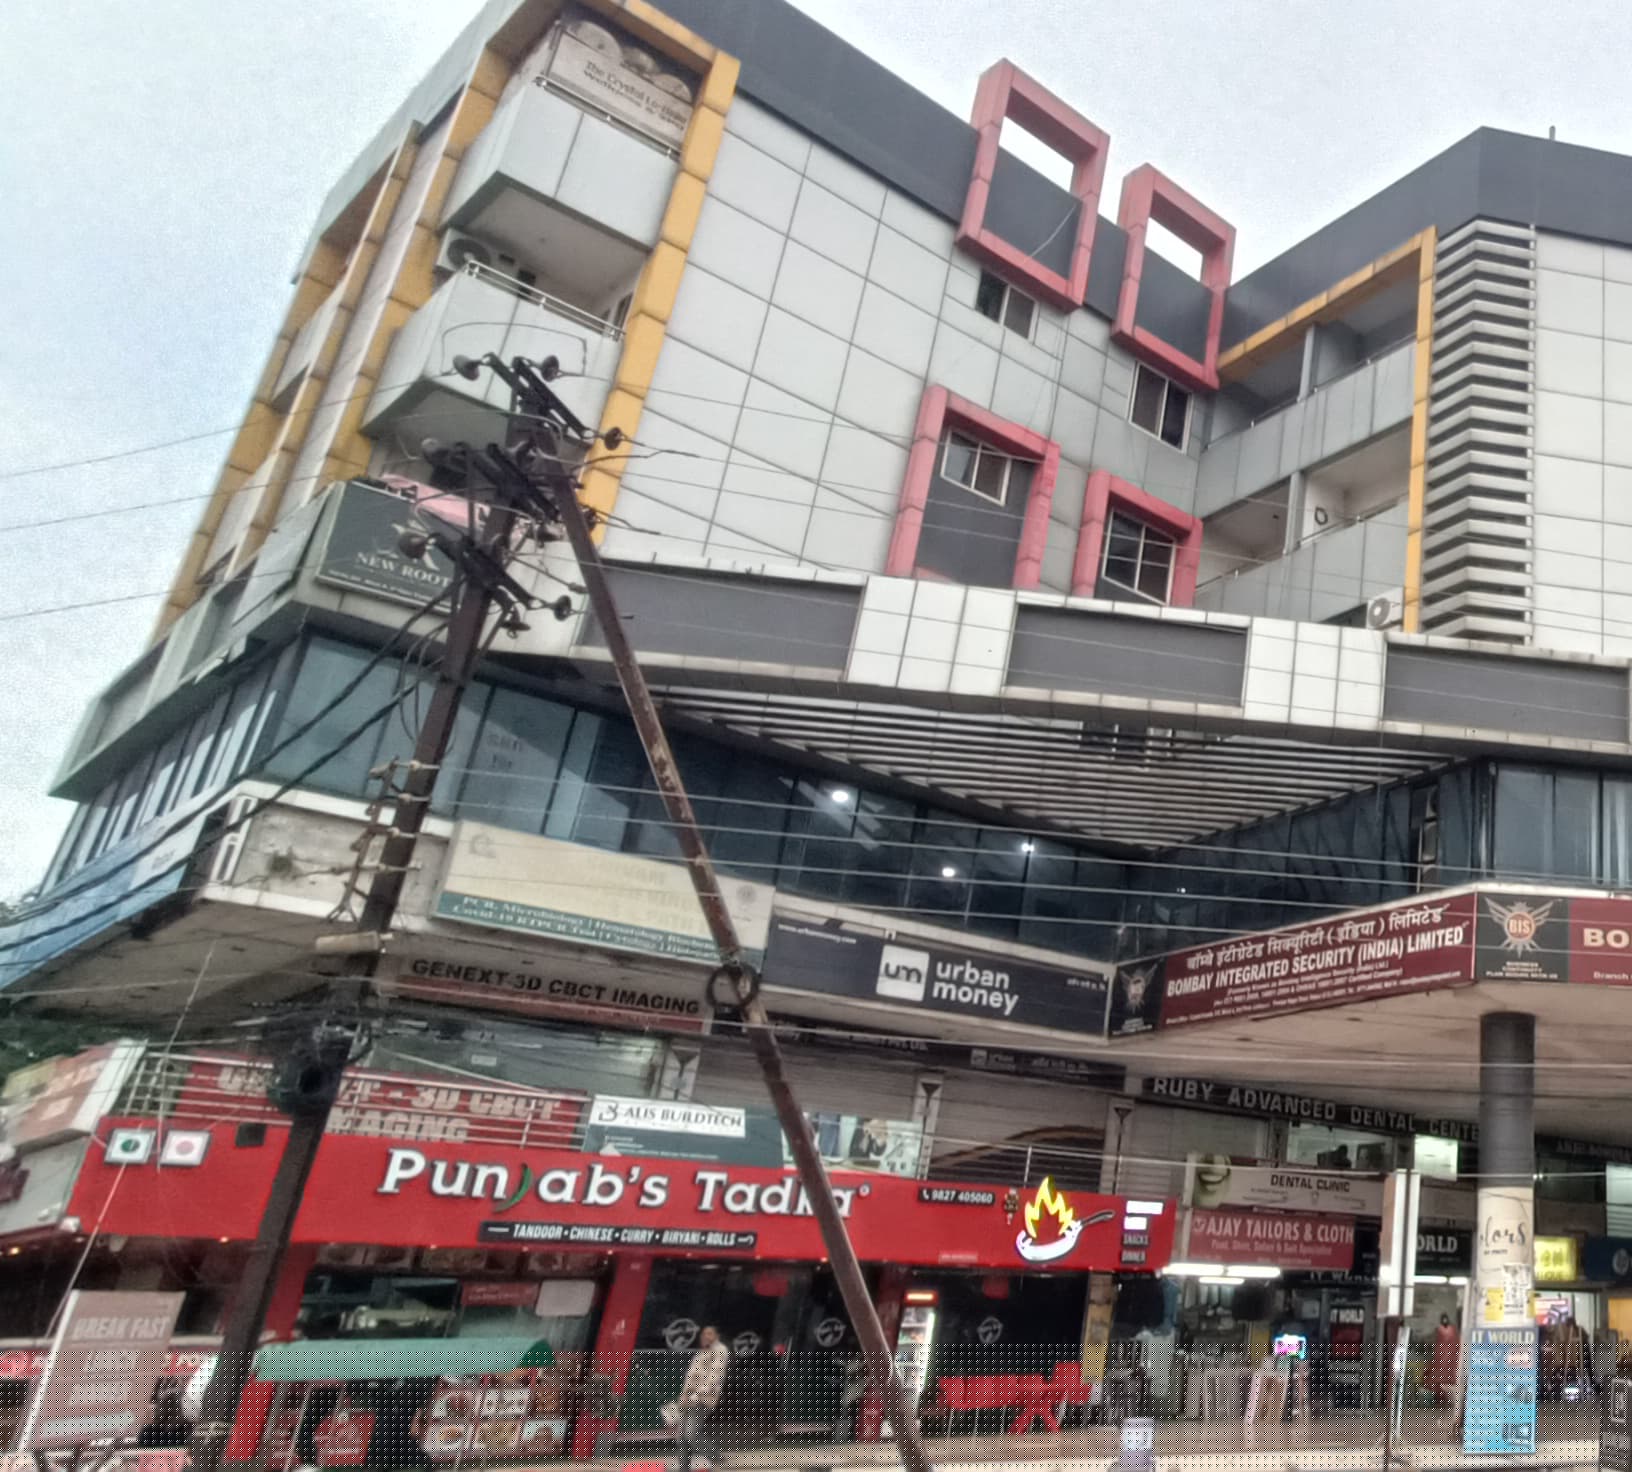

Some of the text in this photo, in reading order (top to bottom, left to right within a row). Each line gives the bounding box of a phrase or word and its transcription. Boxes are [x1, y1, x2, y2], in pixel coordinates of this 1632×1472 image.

[1508, 917, 1532, 934] BIS
[880, 961, 924, 986] um
[1166, 971, 1214, 998] BOMBAY
[1215, 958, 1290, 988] INTEGRATED
[1291, 944, 1356, 976] SECURITY
[1357, 935, 1404, 967] (INDIA)
[1407, 925, 1464, 954] LIMITED
[934, 959, 1011, 990] urban
[1593, 971, 1629, 981] Branch
[547, 978, 607, 1001] CBCT
[611, 987, 700, 1015] IMAGING
[931, 982, 1019, 1017] money
[623, 1106, 743, 1128] ALIS BUILDTECH
[1152, 1076, 1480, 1142] RUBY ADVANCED DENTAL CENTE
[326, 1106, 471, 1142] MAGING
[376, 1147, 669, 1214] Punjab's
[1270, 1174, 1351, 1193] DENTAL CLINIC
[930, 1189, 956, 1202] 9827
[512, 1223, 562, 1238] TANDOOR
[569, 1227, 613, 1242] CHINESE
[620, 1229, 654, 1243] CURRY
[705, 1232, 736, 1246] ROLLS
[1206, 1216, 1355, 1244] AJAY TAILORS & CLOTH
[1417, 1235, 1458, 1253] ORLD
[131, 1315, 171, 1338] FAST
[1471, 1330, 1536, 1344] IT WORLD
